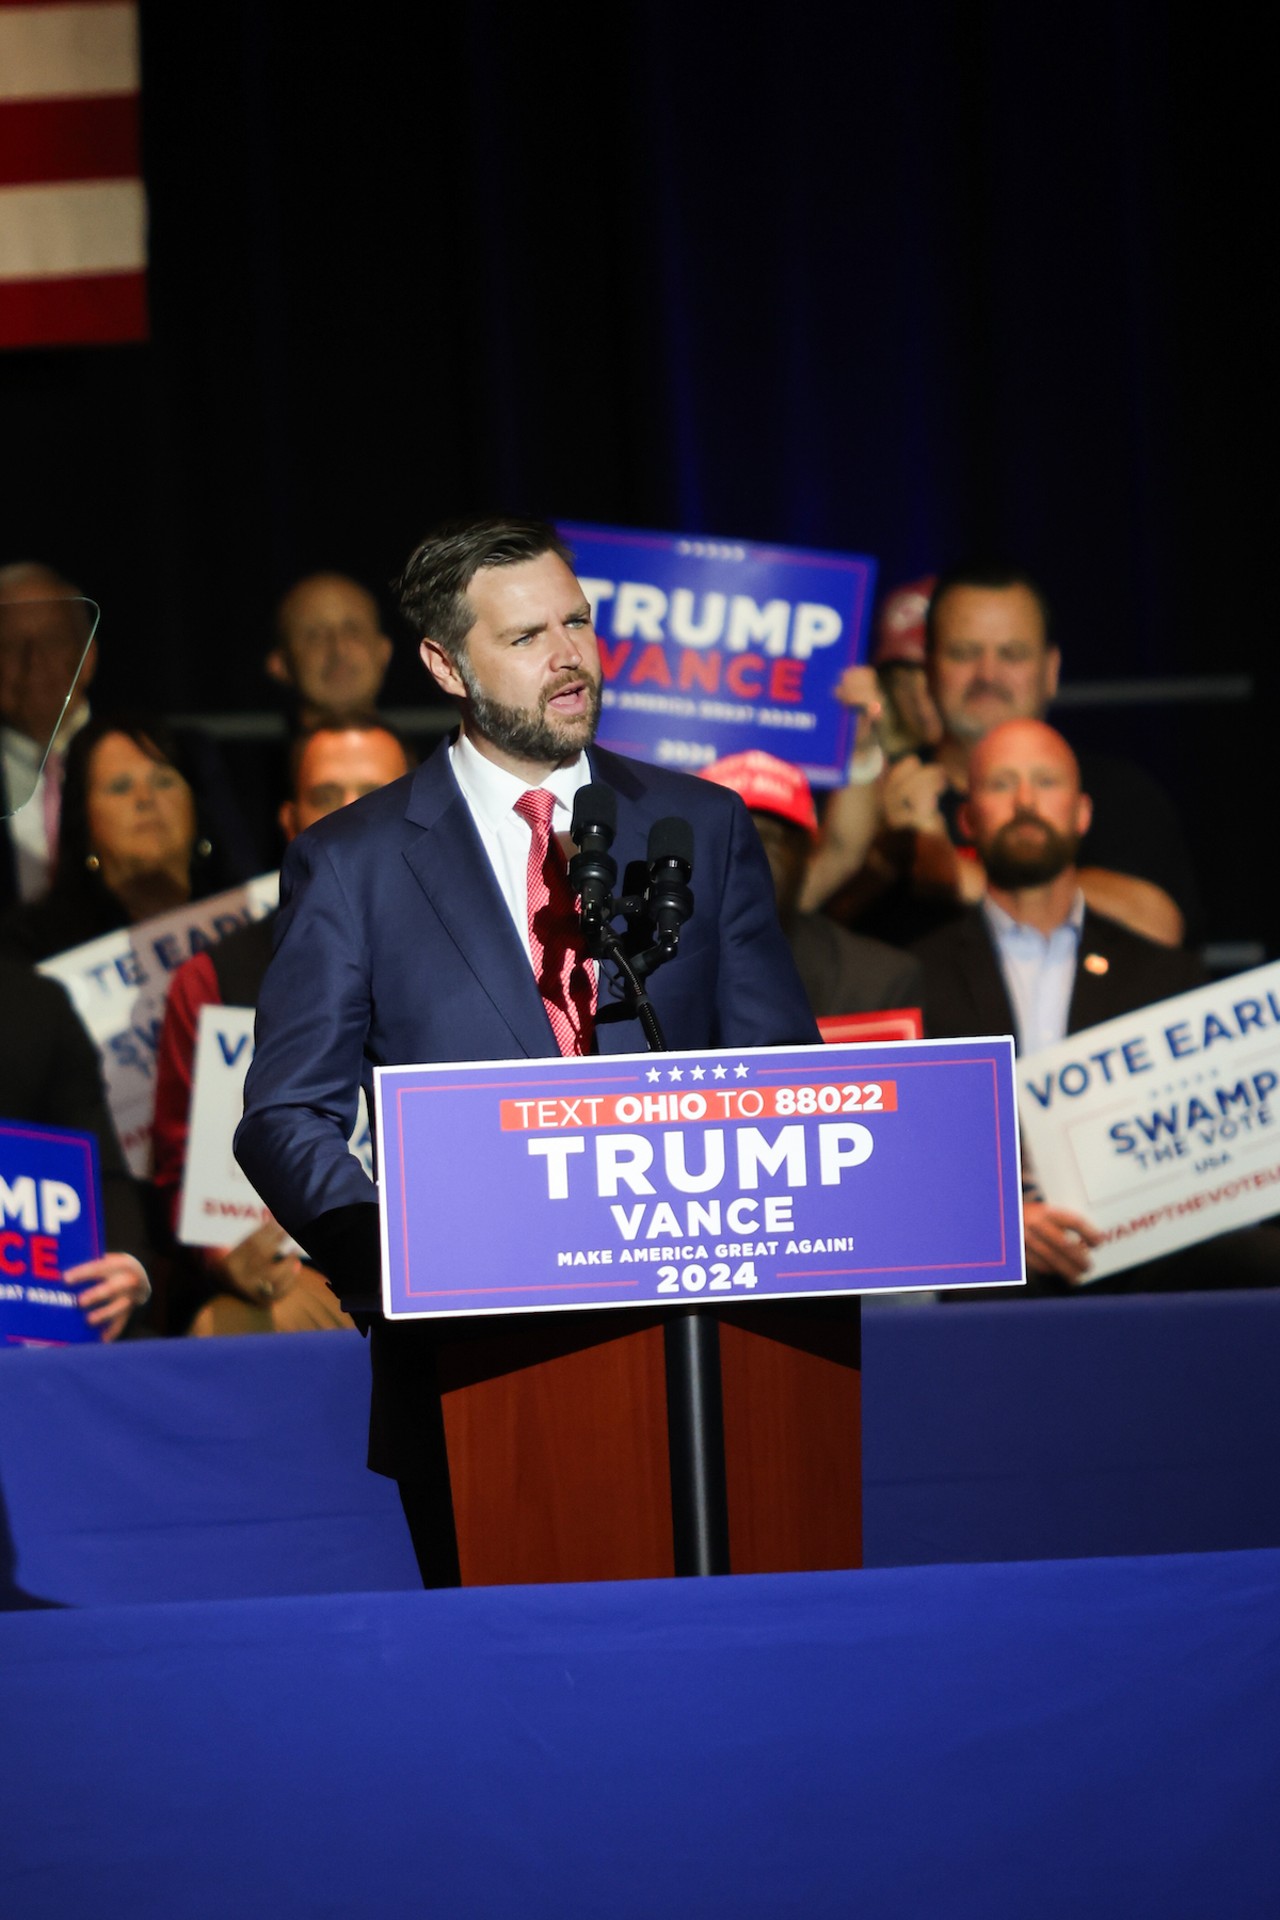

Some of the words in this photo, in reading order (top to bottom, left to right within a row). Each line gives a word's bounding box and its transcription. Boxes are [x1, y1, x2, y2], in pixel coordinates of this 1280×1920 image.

[575, 577, 843, 660] TRUMP
[597, 638, 807, 703] VANCE
[515, 1098, 604, 1128] TEXT
[615, 1092, 707, 1124] OHIO
[716, 1090, 764, 1117] TO
[774, 1083, 884, 1115] 88022
[1026, 1036, 1154, 1109] VOTE
[1109, 1070, 1279, 1154] SWAMP
[1136, 1134, 1185, 1169] THE
[1201, 1102, 1271, 1145] VOTE
[527, 1122, 874, 1200] TRUMP
[610, 1196, 795, 1240] VANCE
[557, 1249, 613, 1266] MAKE
[619, 1246, 709, 1264] AMERICA
[714, 1241, 779, 1258] GREAT
[785, 1237, 855, 1255] AGAIN!
[656, 1261, 758, 1293] 2024
